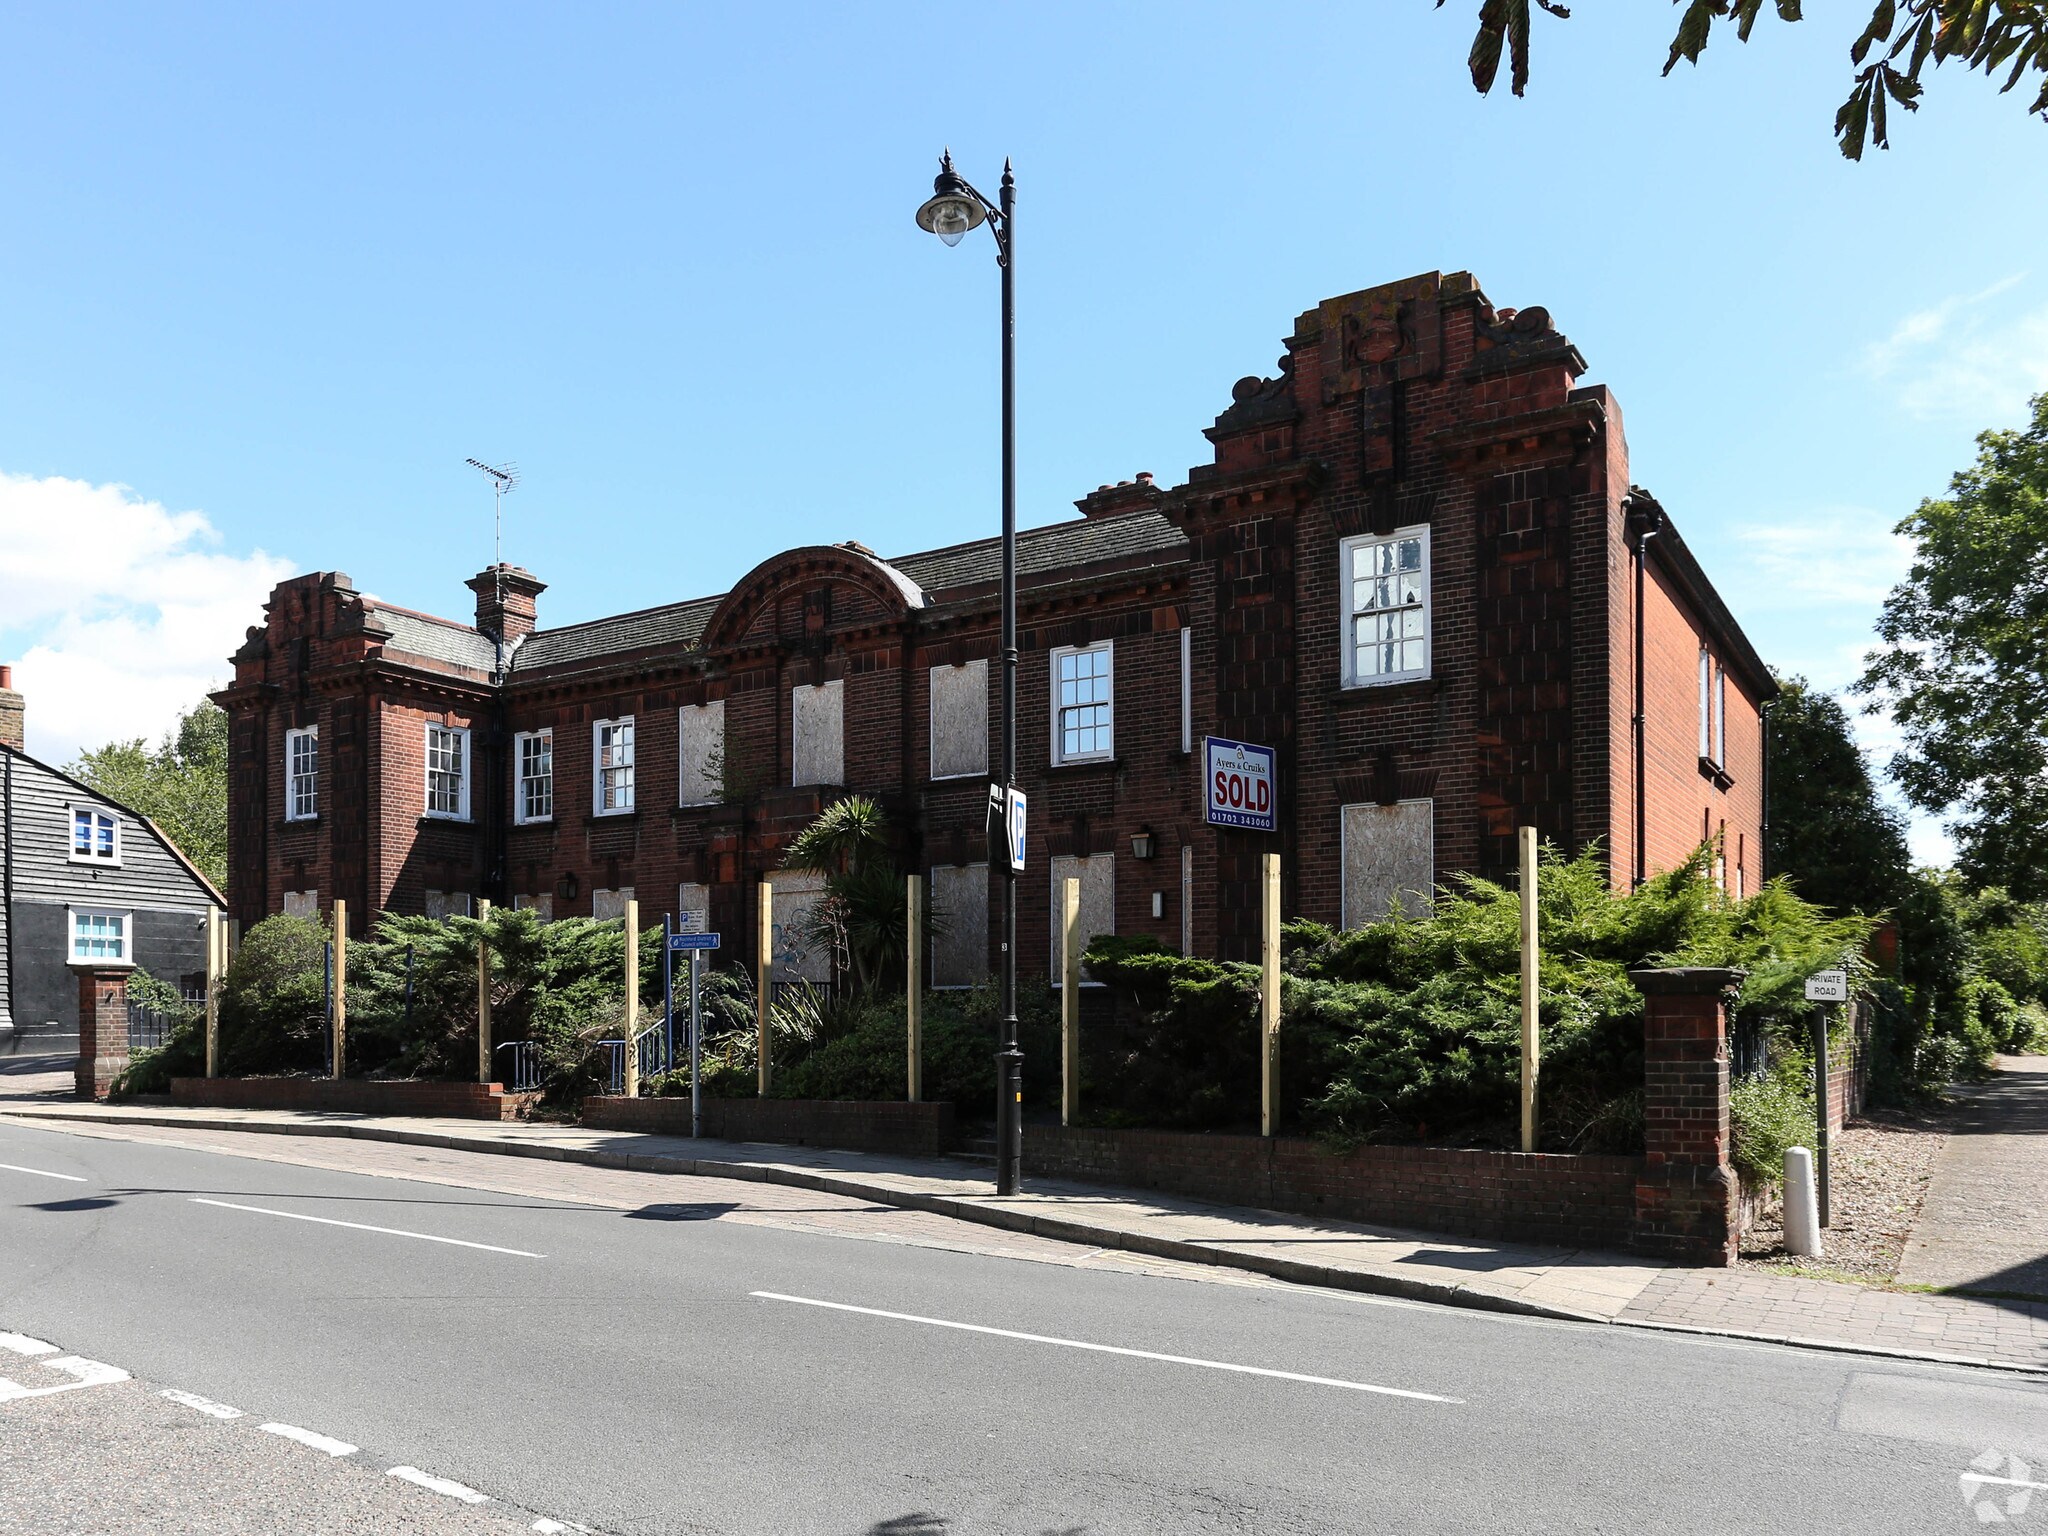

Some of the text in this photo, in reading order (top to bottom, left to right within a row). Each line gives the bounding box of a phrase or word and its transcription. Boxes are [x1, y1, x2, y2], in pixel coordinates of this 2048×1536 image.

[1216, 758, 1236, 769] Ayers
[1242, 761, 1266, 773] Cruiks
[1215, 770, 1270, 813] SOLD
[1211, 812, 1270, 827] 01702 343060
[1017, 805, 1024, 857] P
[1810, 975, 1841, 984] PRIVATE
[1814, 986, 1836, 995] ROAD
